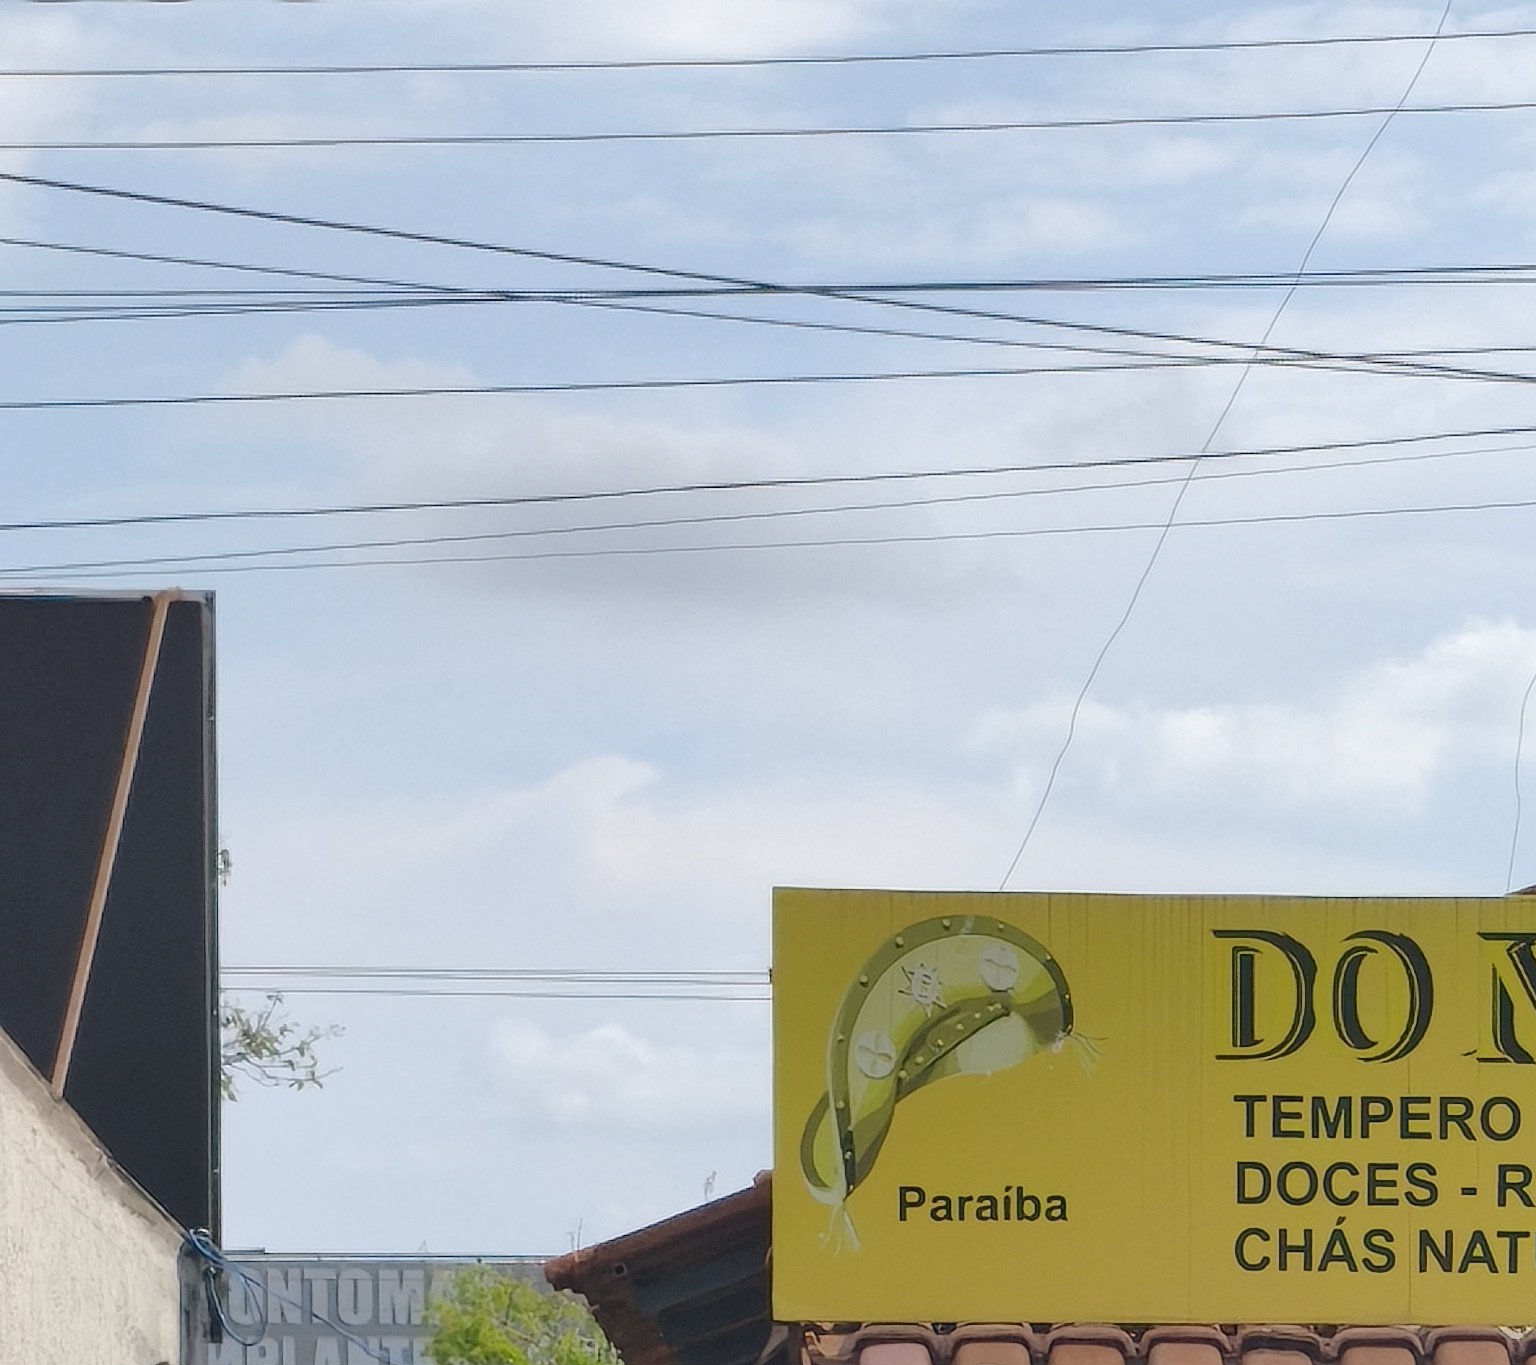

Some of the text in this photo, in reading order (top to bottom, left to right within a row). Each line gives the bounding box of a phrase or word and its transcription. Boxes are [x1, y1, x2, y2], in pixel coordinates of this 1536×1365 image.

[1211, 929, 1434, 1064] DO
[1233, 1094, 1521, 1142] TEMPERO
[898, 1185, 1069, 1222] Paraíba
[1236, 1161, 1439, 1207] DOCES
[1234, 1216, 1396, 1274] CHÁS
